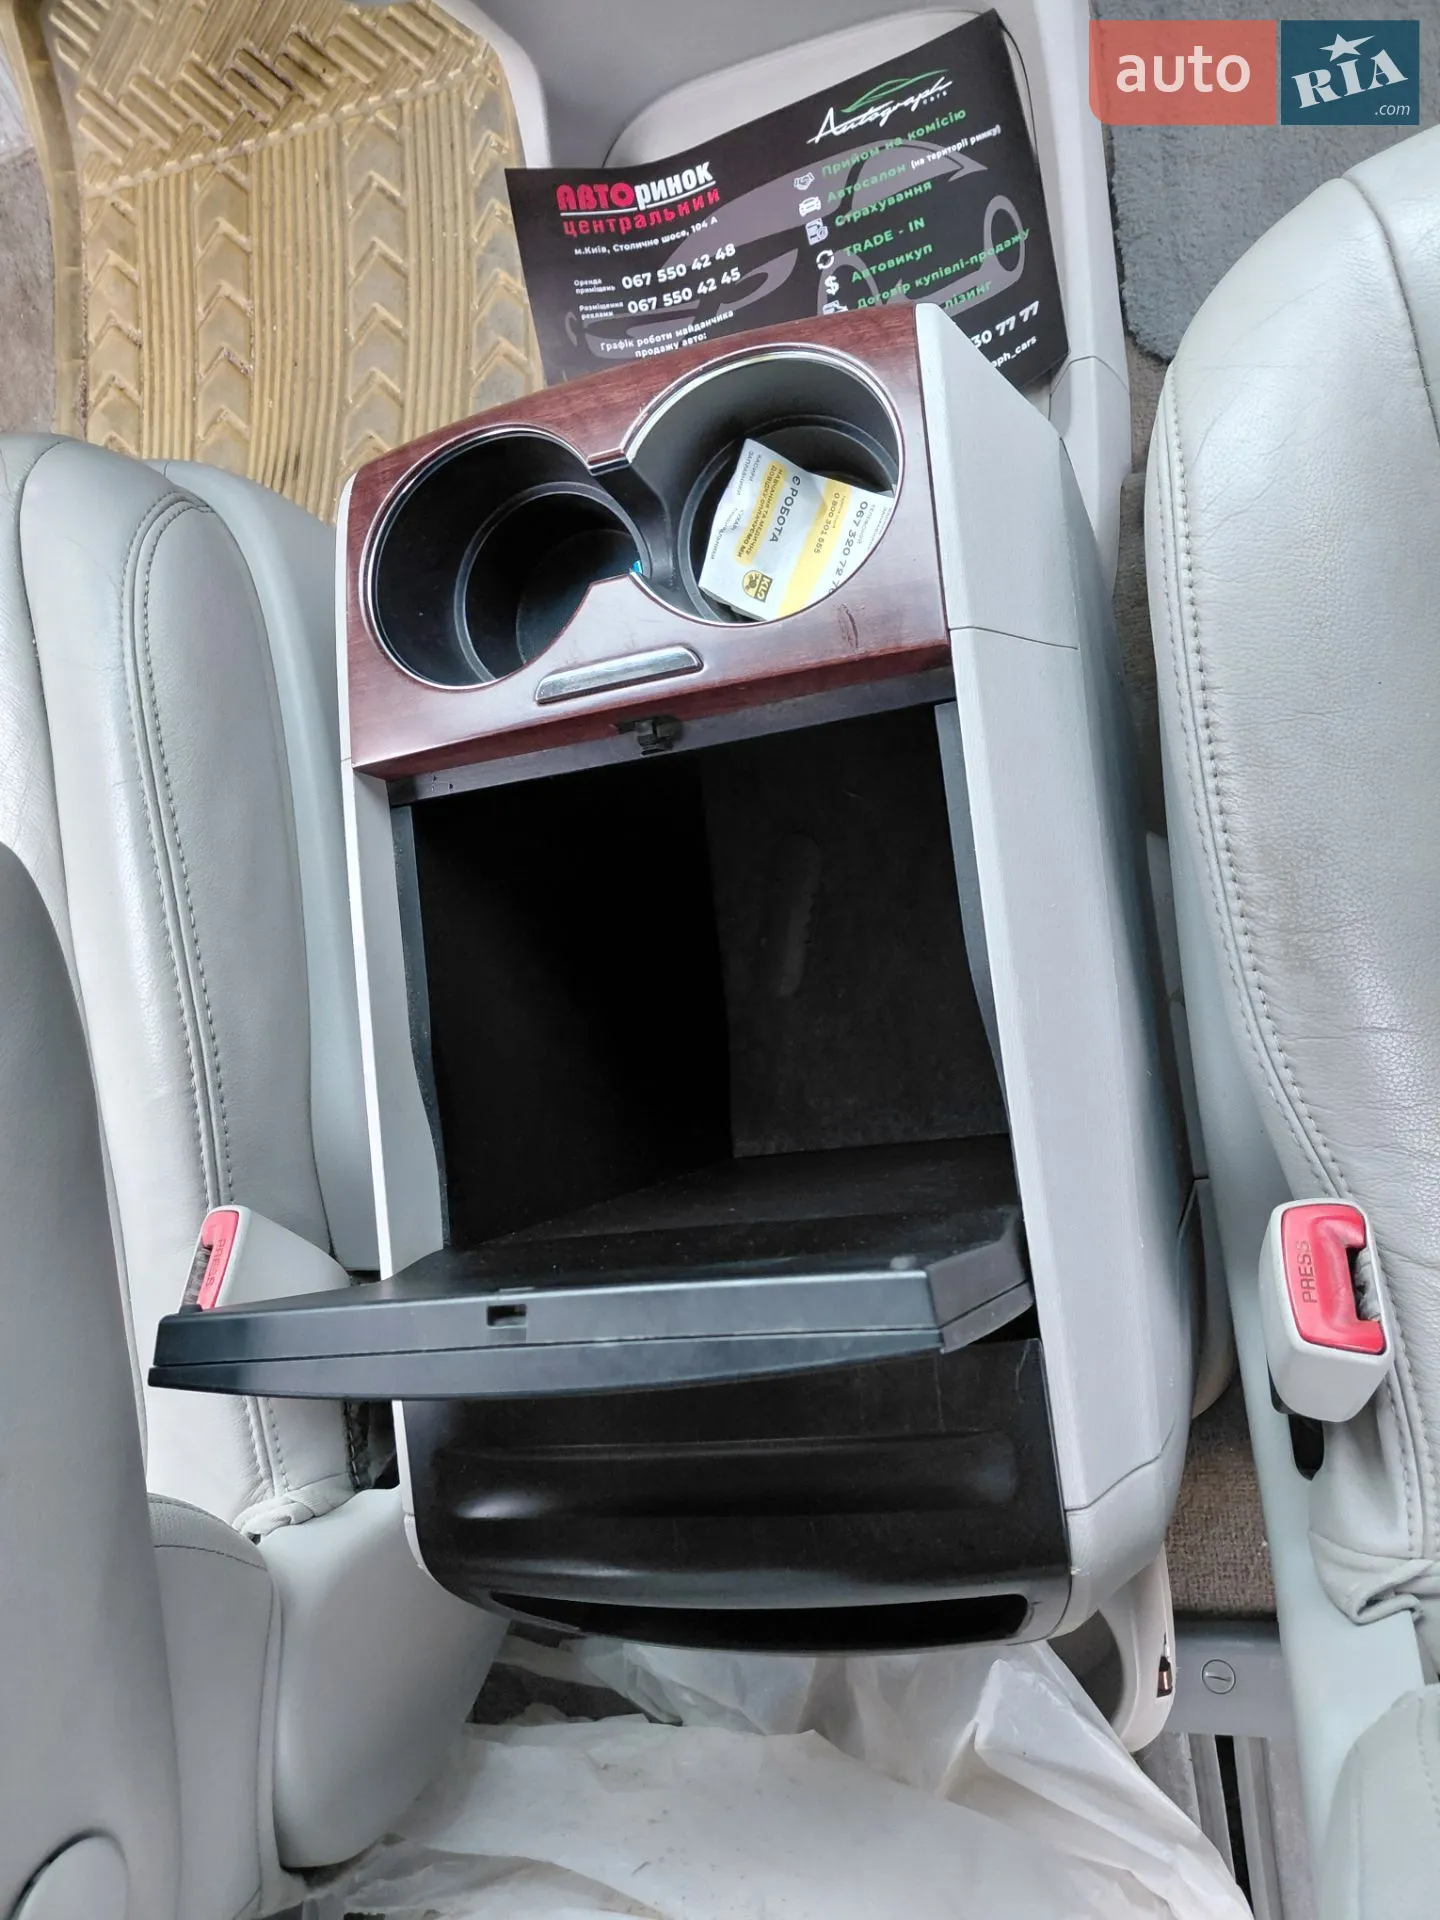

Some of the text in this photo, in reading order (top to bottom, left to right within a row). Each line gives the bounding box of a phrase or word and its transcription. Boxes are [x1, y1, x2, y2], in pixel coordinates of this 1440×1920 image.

[806, 76, 953, 144] Autograph
[821, 146, 880, 178] Прийом
[884, 137, 903, 151] на
[827, 163, 907, 204] Автосалон
[834, 181, 932, 227] Страхування
[612, 238, 660, 252] Столичне
[661, 230, 690, 244] шосе,
[691, 221, 708, 233] 104
[843, 230, 894, 257] TRADE
[908, 217, 925, 233] IN
[621, 243, 736, 289] 067 550 42 48
[851, 244, 933, 283] Автовикуп
[857, 228, 1030, 309] Договір купівлі-продажу
[627, 267, 741, 314] 067 550 42 45
[943, 280, 993, 309] лізинг
[600, 310, 734, 352] Графік роботи майданчика
[995, 315, 1016, 337] 77
[1019, 300, 1040, 323] 77
[635, 332, 707, 358] продажу авто:
[769, 486, 799, 543] РОБОТА
[853, 501, 868, 527] 067
[842, 529, 857, 556] 320
[835, 559, 847, 577] 72
